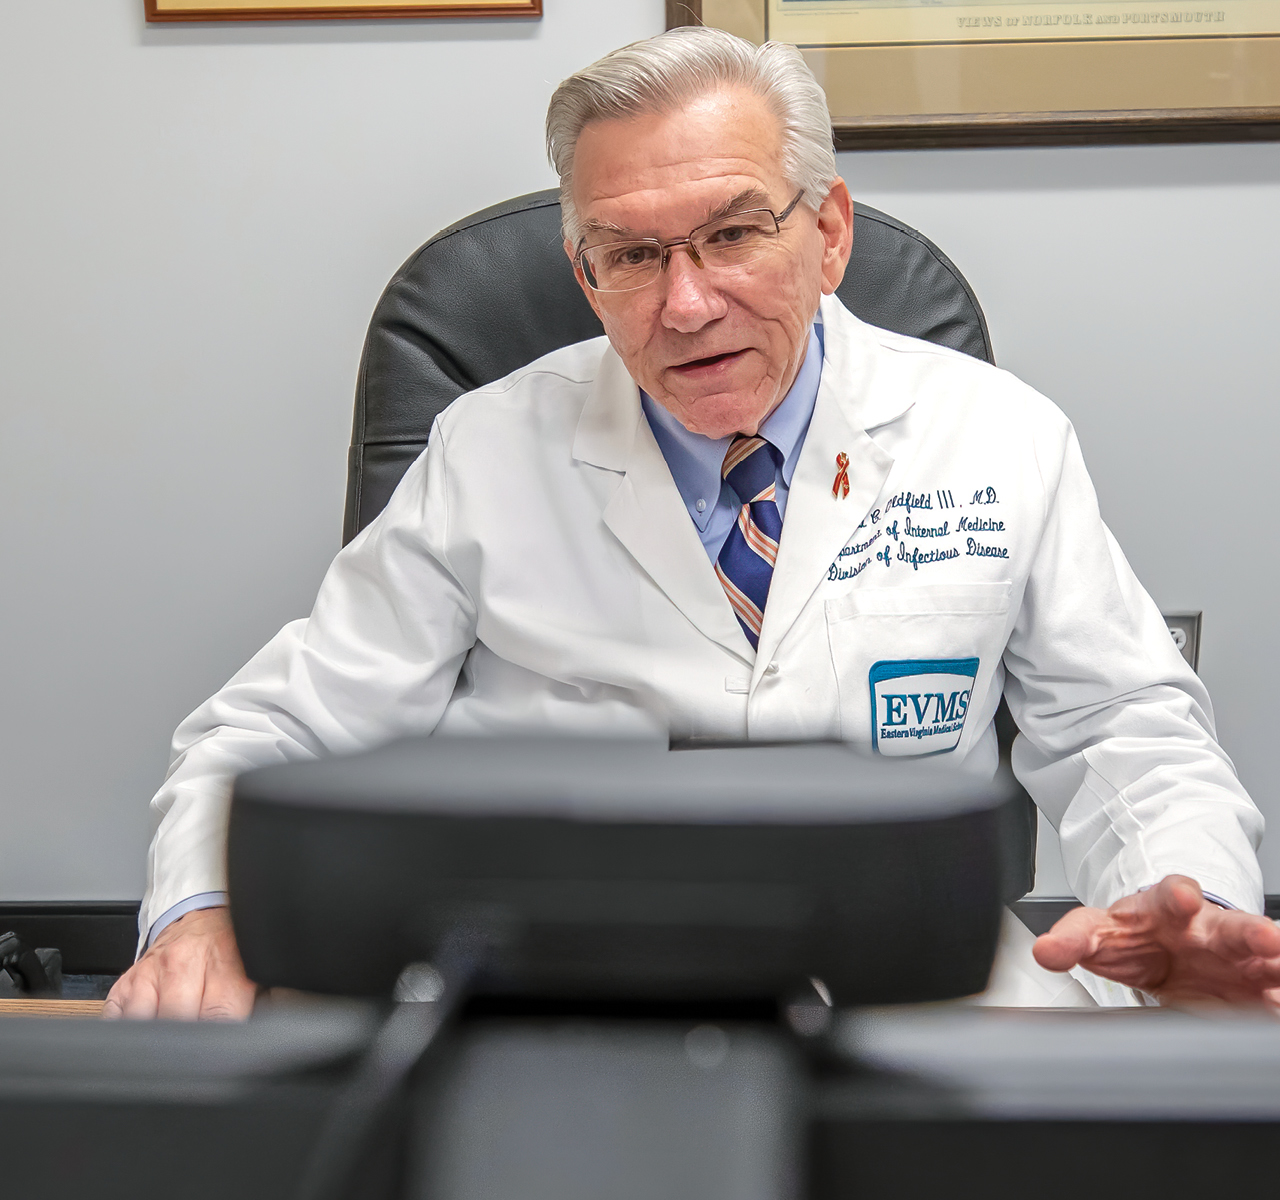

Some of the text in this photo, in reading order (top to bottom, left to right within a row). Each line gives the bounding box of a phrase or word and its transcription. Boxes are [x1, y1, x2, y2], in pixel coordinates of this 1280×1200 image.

[957, 16, 1002, 28] VIEWS
[1022, 13, 1093, 26] NORFOLK
[1095, 14, 1120, 25] AND
[1122, 11, 1226, 24] PORTSMOUTH
[969, 486, 1000, 505] M.D.
[837, 529, 883, 562] partment
[886, 520, 900, 541] of
[904, 516, 951, 538] Internal
[955, 516, 1006, 533] Medicine
[827, 537, 1010, 582] Division of Infectious Disease
[880, 689, 970, 726] EVMS
[880, 728, 909, 739] Eastern
[909, 726, 933, 740] Virginia
